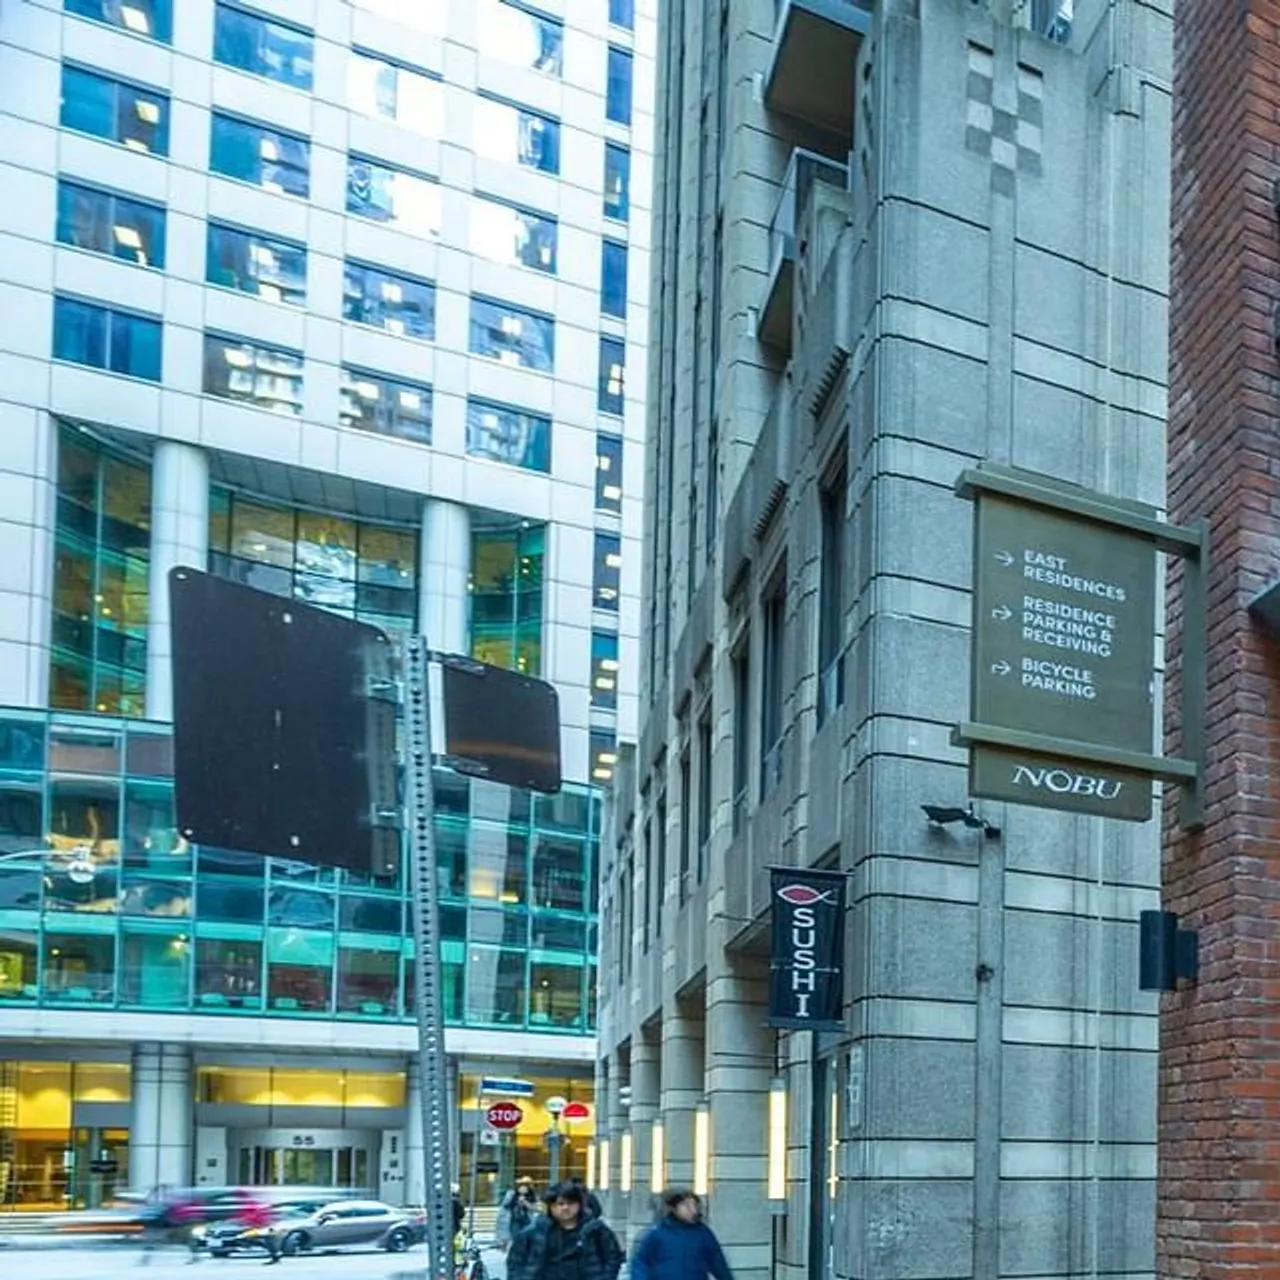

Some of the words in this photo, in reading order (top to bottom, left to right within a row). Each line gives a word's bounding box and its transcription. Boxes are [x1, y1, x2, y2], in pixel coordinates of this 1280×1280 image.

[1024, 550, 1067, 570] EAST
[1024, 565, 1126, 601] RESIDENCES
[1023, 596, 1116, 628] RESIDENCE
[1022, 627, 1111, 657] RECEIVING
[1023, 612, 1097, 639] PARKING
[1100, 629, 1112, 643] &
[1022, 658, 1093, 683] BICYCLE
[1021, 673, 1096, 699] PARKING
[1012, 765, 1125, 799] NOBU
[792, 907, 816, 1017] SUSHI
[489, 1109, 520, 1122] STOP
